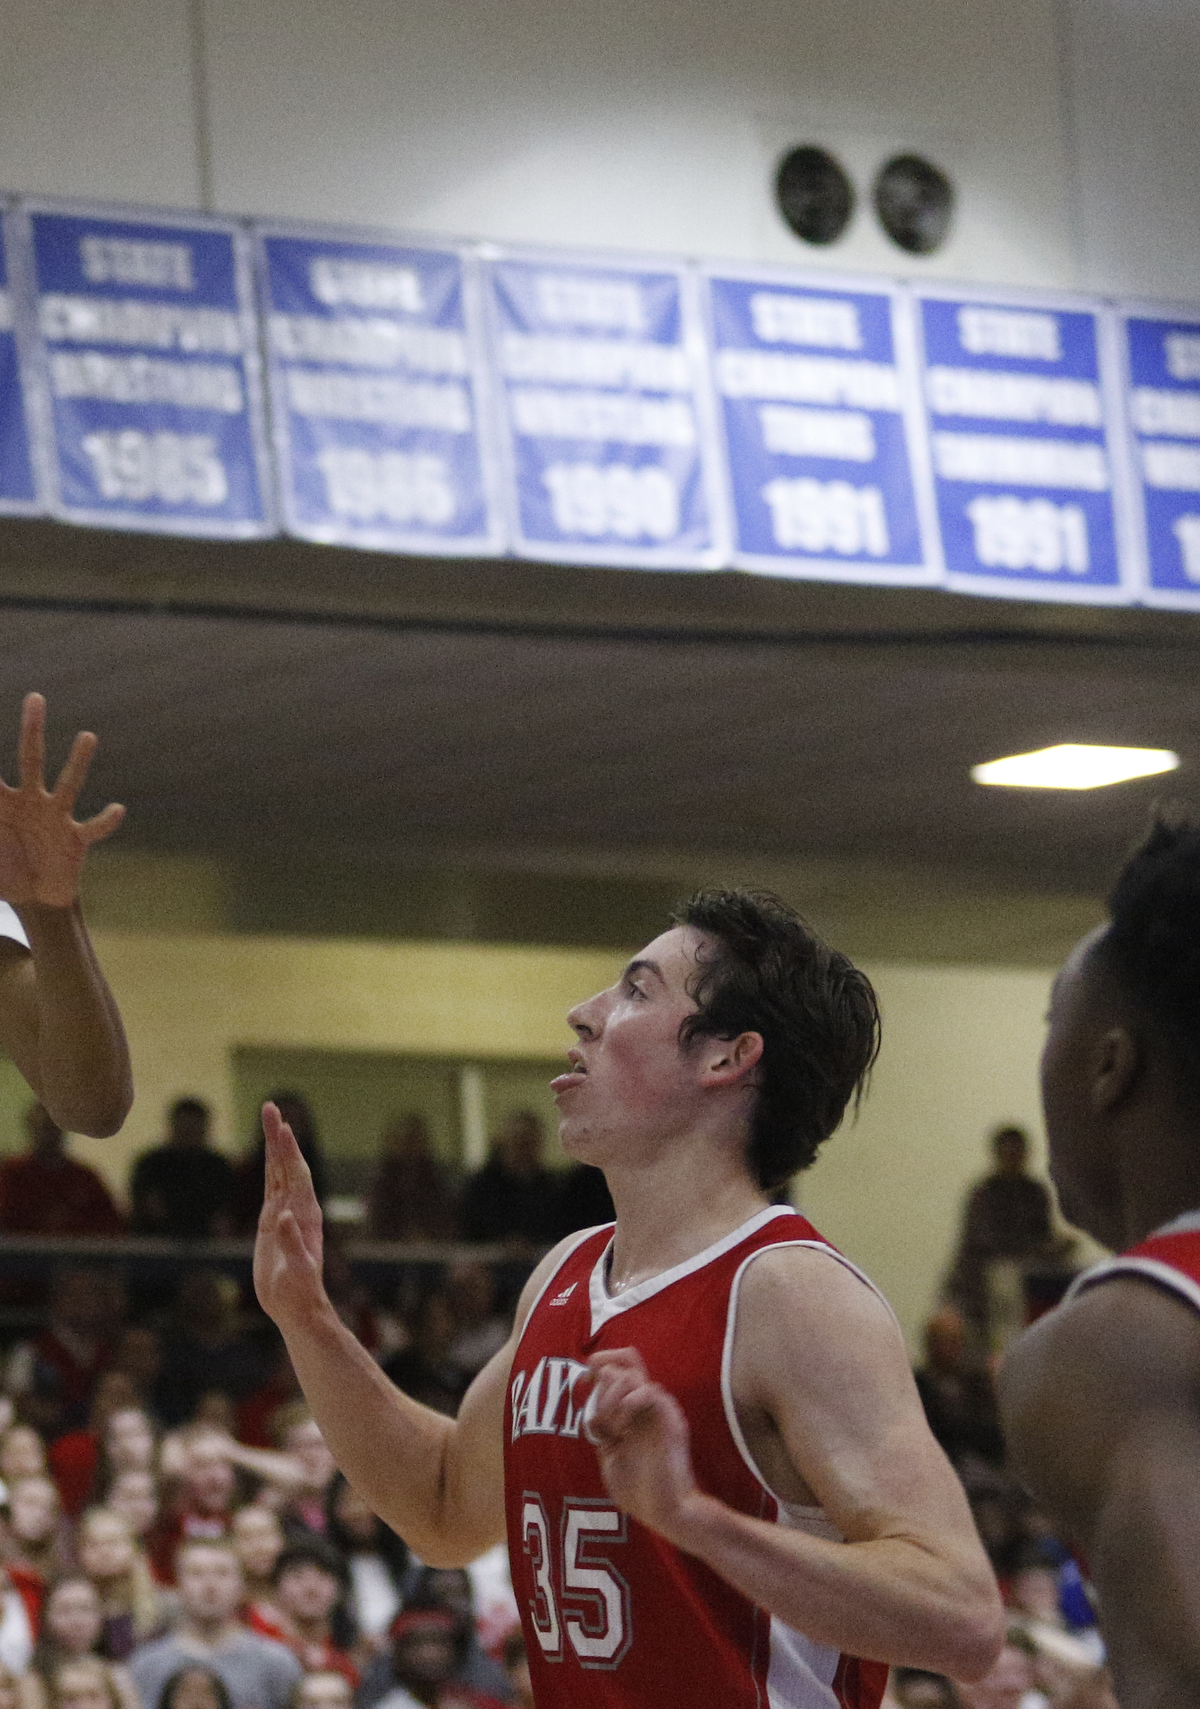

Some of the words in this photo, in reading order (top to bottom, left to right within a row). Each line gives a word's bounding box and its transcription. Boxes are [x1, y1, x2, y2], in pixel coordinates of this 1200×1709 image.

[80, 235, 195, 291] STATE
[41, 294, 241, 355] CHAMPION
[750, 292, 864, 350] STATE
[958, 306, 1062, 362] STATE
[719, 348, 898, 411] CHAMPION
[929, 365, 1102, 428] CHAMPION
[762, 476, 890, 556] 1991
[967, 497, 1088, 574] 1991
[523, 1490, 633, 1671] 35
